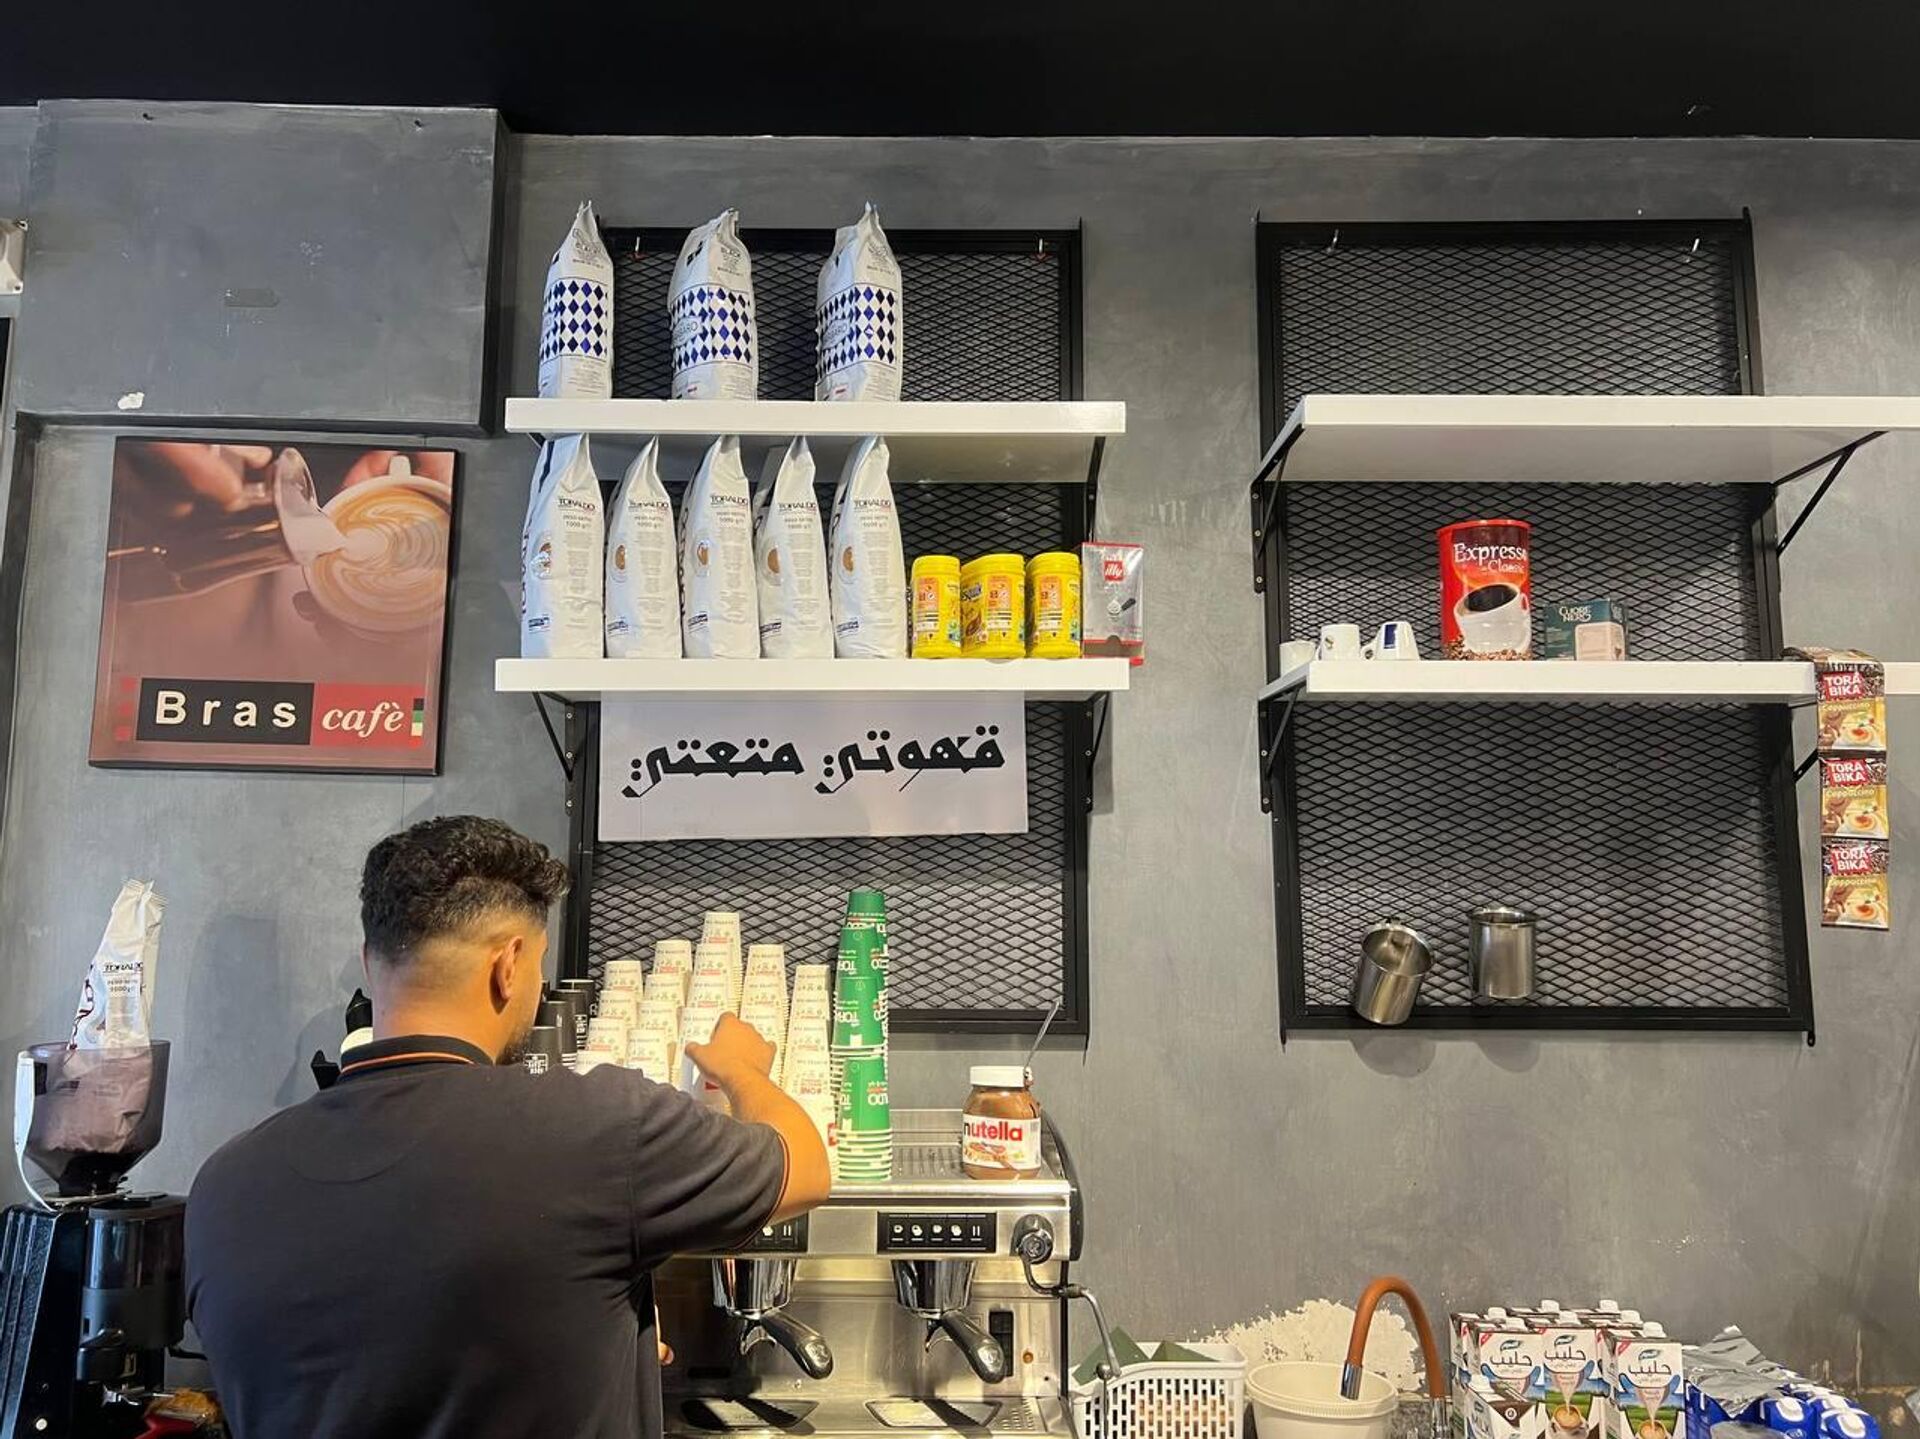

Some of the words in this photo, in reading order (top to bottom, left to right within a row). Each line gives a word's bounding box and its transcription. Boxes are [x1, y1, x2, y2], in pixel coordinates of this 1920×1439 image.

[1105, 562, 1123, 578] illy
[1823, 673, 1862, 687] TORA
[1829, 684, 1862, 696] BIKA
[155, 690, 297, 729] Bras
[321, 702, 405, 738] cafè
[814, 725, 1005, 794] قهوتي
[1828, 761, 1865, 773] TORA
[621, 738, 805, 798] متعتي
[1833, 771, 1866, 782] BIKA
[1831, 847, 1869, 860] TORA
[1837, 860, 1868, 871] BIKA
[963, 1121, 1023, 1142] nutella
[1489, 1350, 1533, 1369] حليب
[1543, 1346, 1587, 1363] حليب
[1628, 1360, 1672, 1377] حليب
